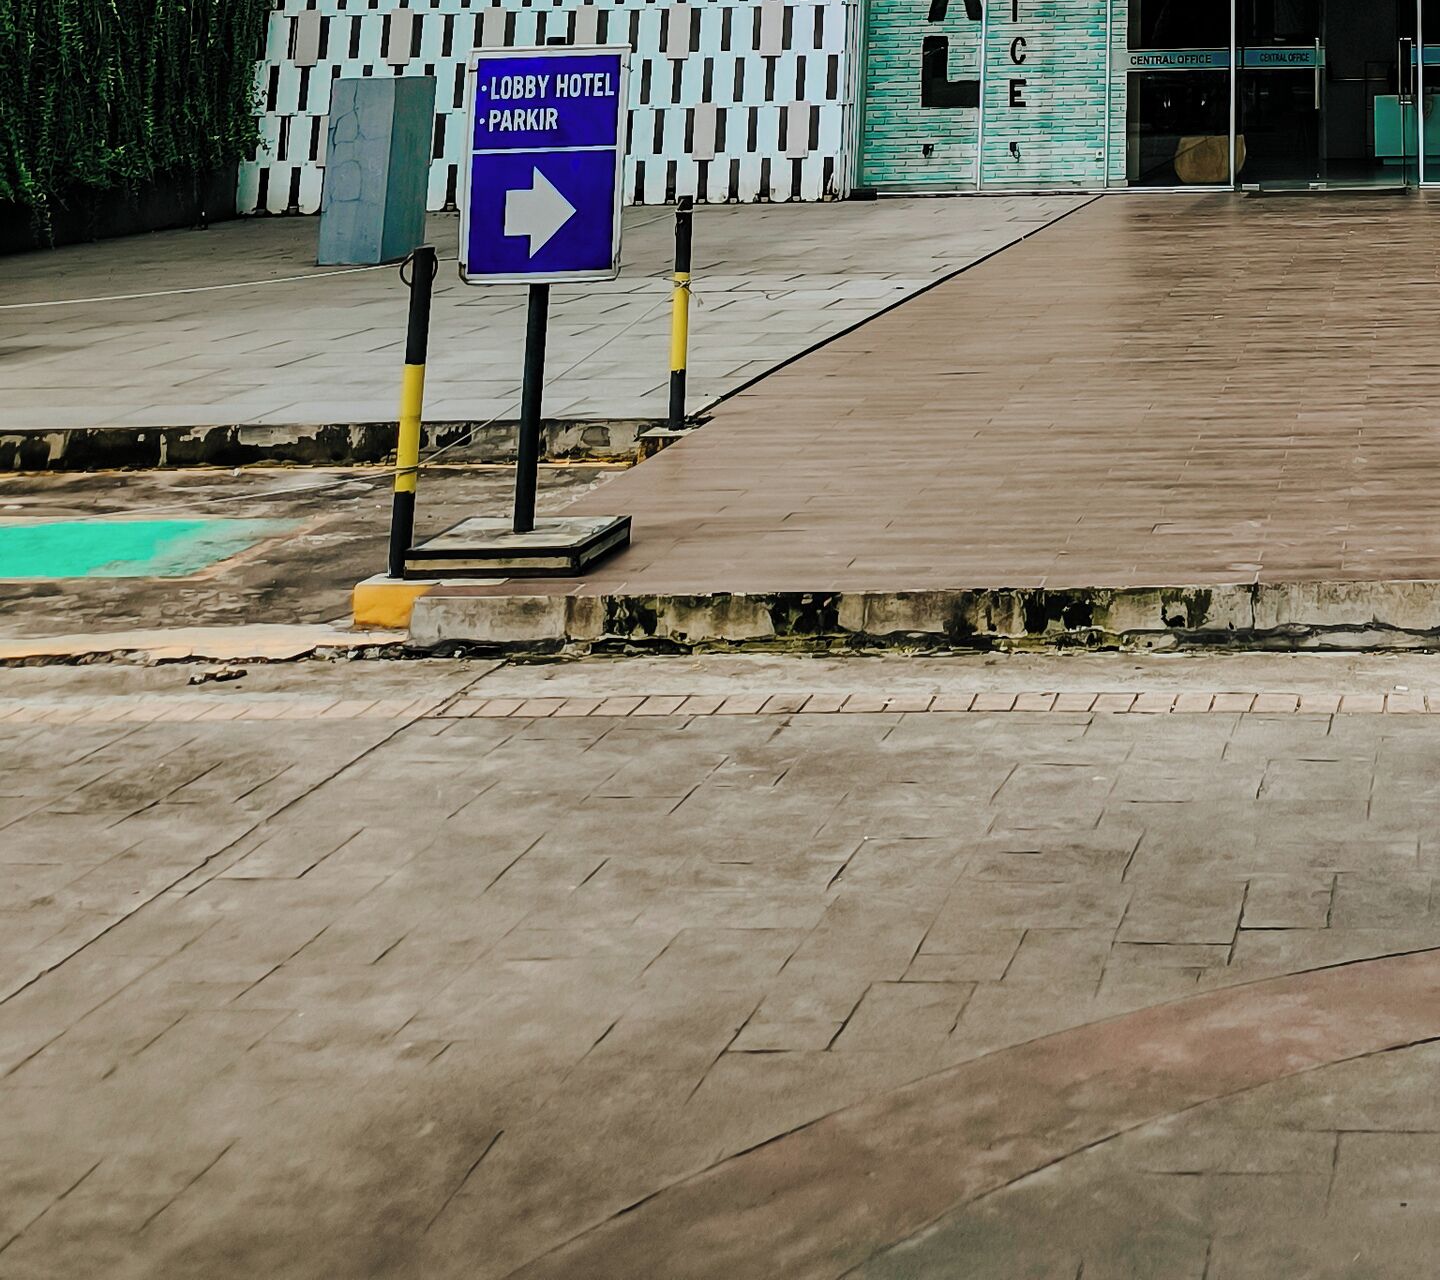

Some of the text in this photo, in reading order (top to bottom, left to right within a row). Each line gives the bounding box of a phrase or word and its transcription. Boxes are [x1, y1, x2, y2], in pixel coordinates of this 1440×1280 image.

[1130, 54, 1212, 65] CENTRAL OFFICE
[1259, 52, 1310, 63] CENTRAL OFFICE
[489, 72, 615, 100] LOBBY HOTEL
[488, 107, 559, 133] PARKIR
